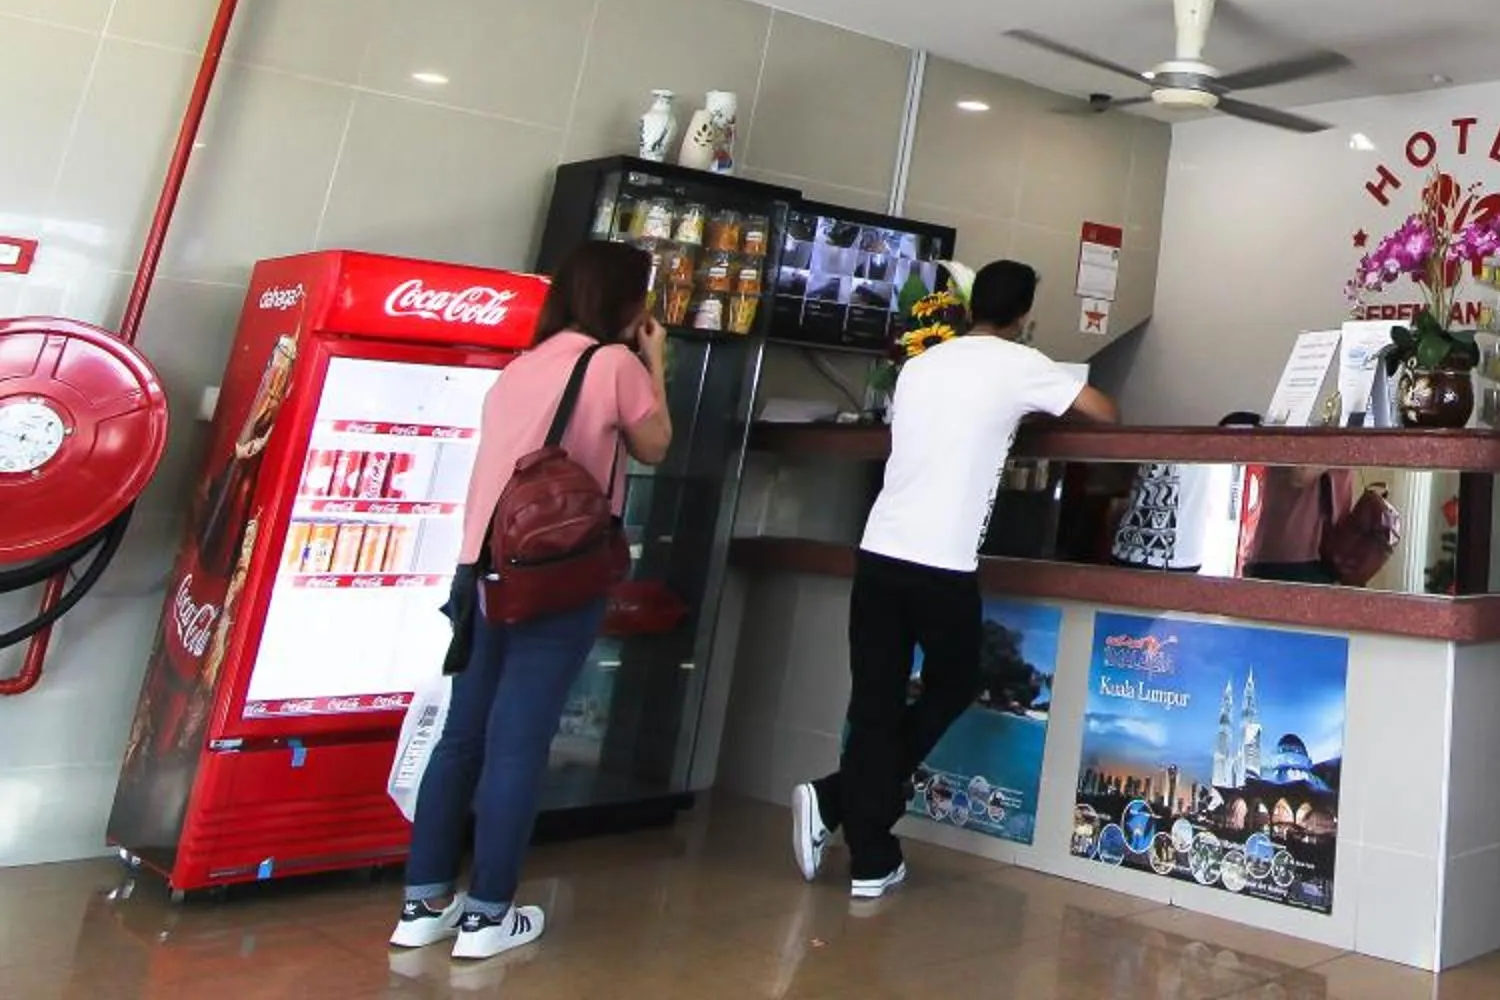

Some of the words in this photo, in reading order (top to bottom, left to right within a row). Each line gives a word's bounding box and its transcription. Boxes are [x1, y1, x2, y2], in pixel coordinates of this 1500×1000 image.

[384, 279, 520, 326] Coca-Cola
[1100, 675, 1135, 699] Kuala
[1138, 681, 1192, 711] Lumpur
